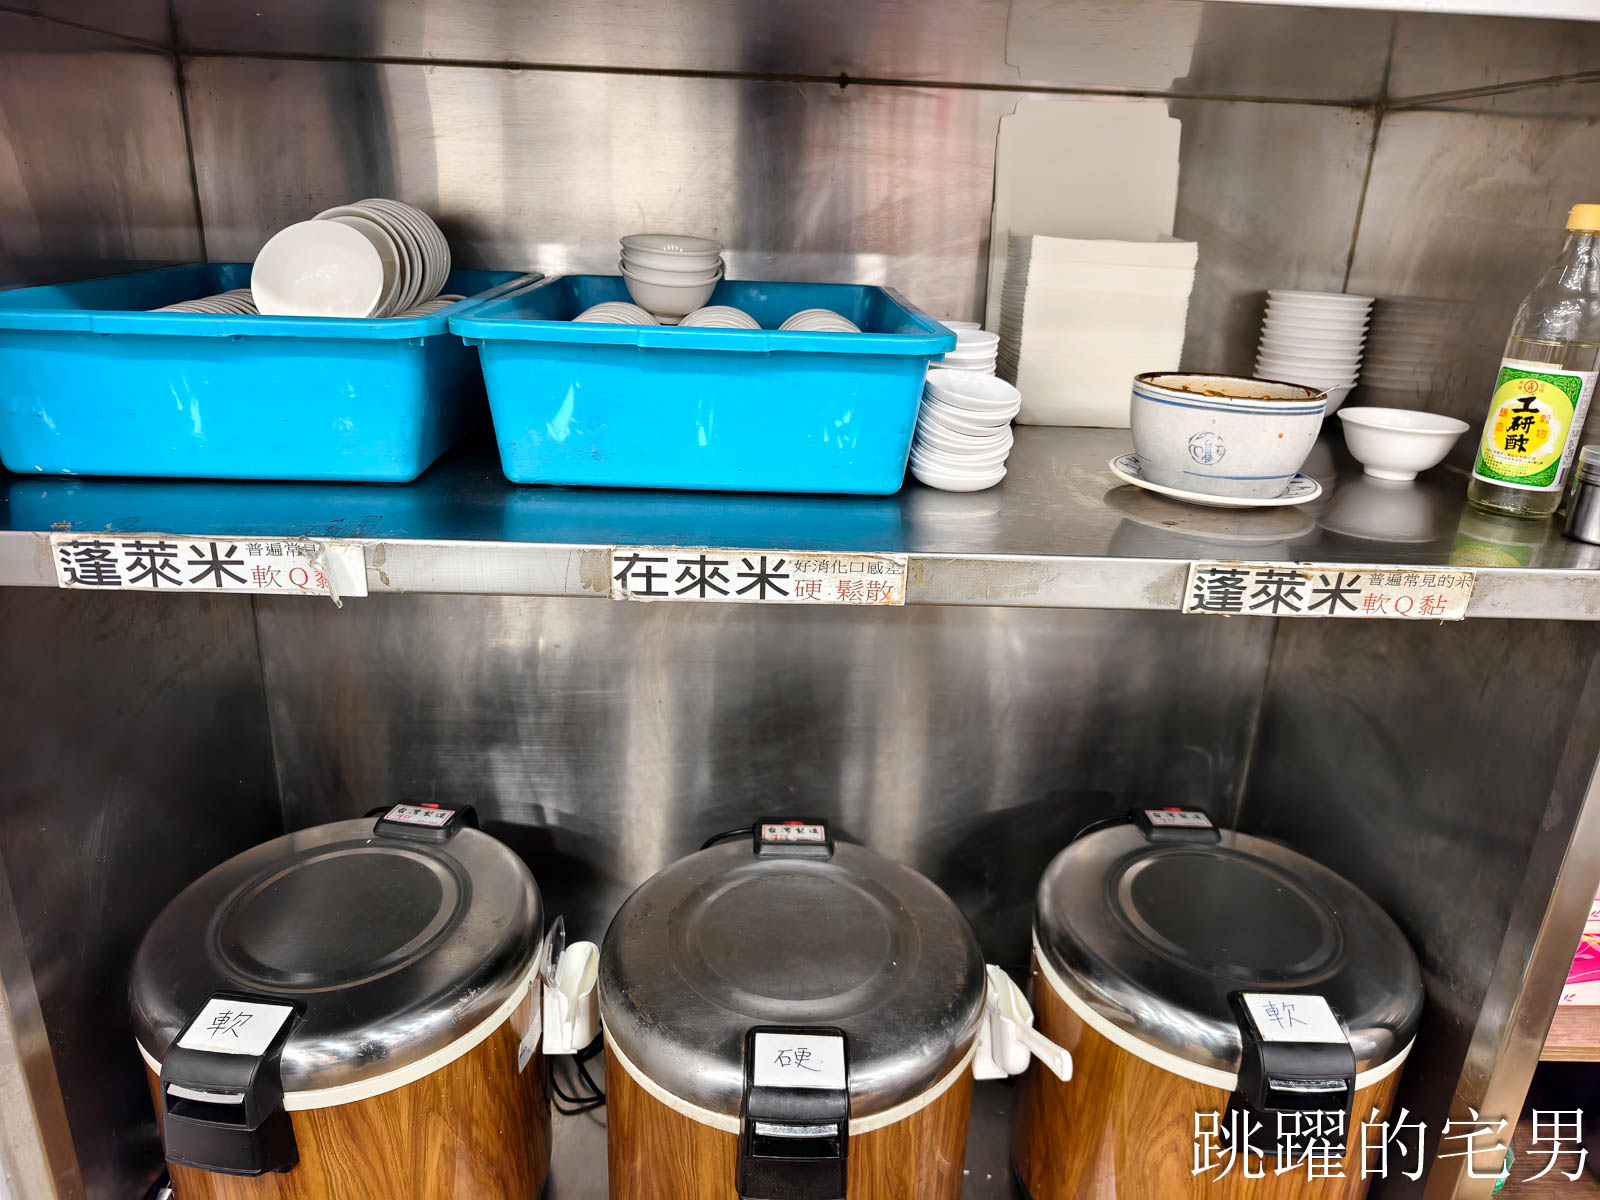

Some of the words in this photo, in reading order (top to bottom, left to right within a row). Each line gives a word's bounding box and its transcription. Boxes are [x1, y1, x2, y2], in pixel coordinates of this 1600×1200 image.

[59, 540, 248, 588] 蓬萊米
[613, 553, 790, 600] 在來米
[1190, 568, 1362, 614] 蓬萊米
[1369, 573, 1472, 588] 普遍常見的米
[206, 1010, 254, 1039] 軟
[1262, 1000, 1308, 1030] 軟
[773, 1047, 822, 1072] 硬
